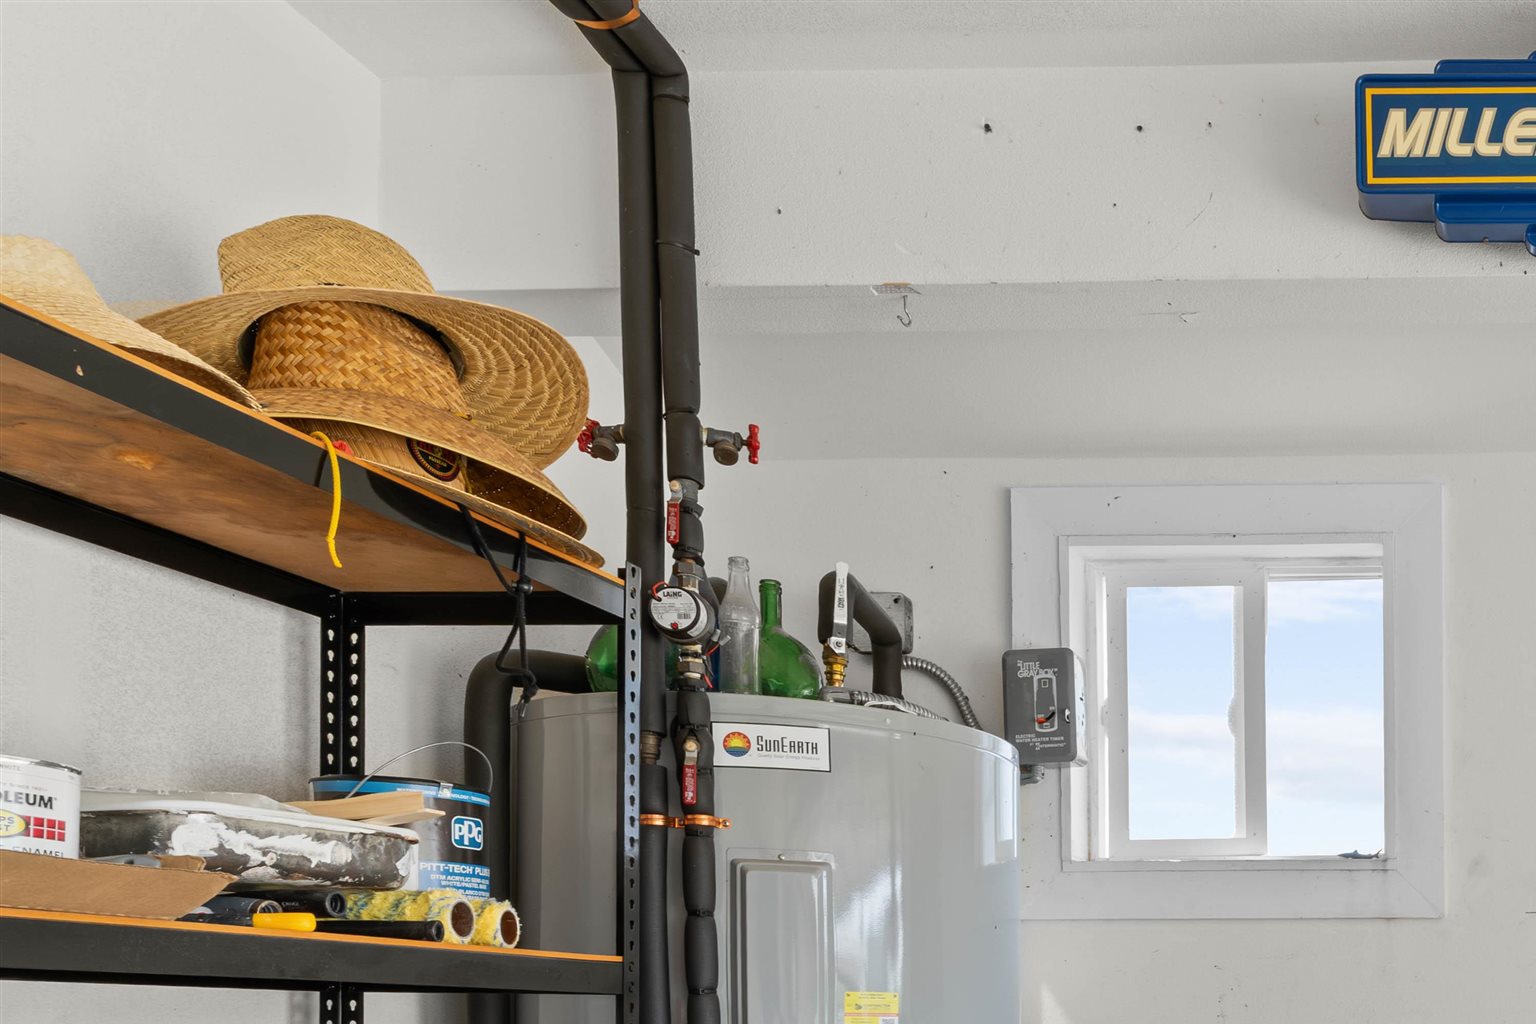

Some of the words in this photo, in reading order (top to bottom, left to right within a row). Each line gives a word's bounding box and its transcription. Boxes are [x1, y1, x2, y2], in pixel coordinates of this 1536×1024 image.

[0, 789, 54, 810] LEUM
[454, 820, 482, 846] PPG
[420, 862, 473, 875] PITT-TECH
